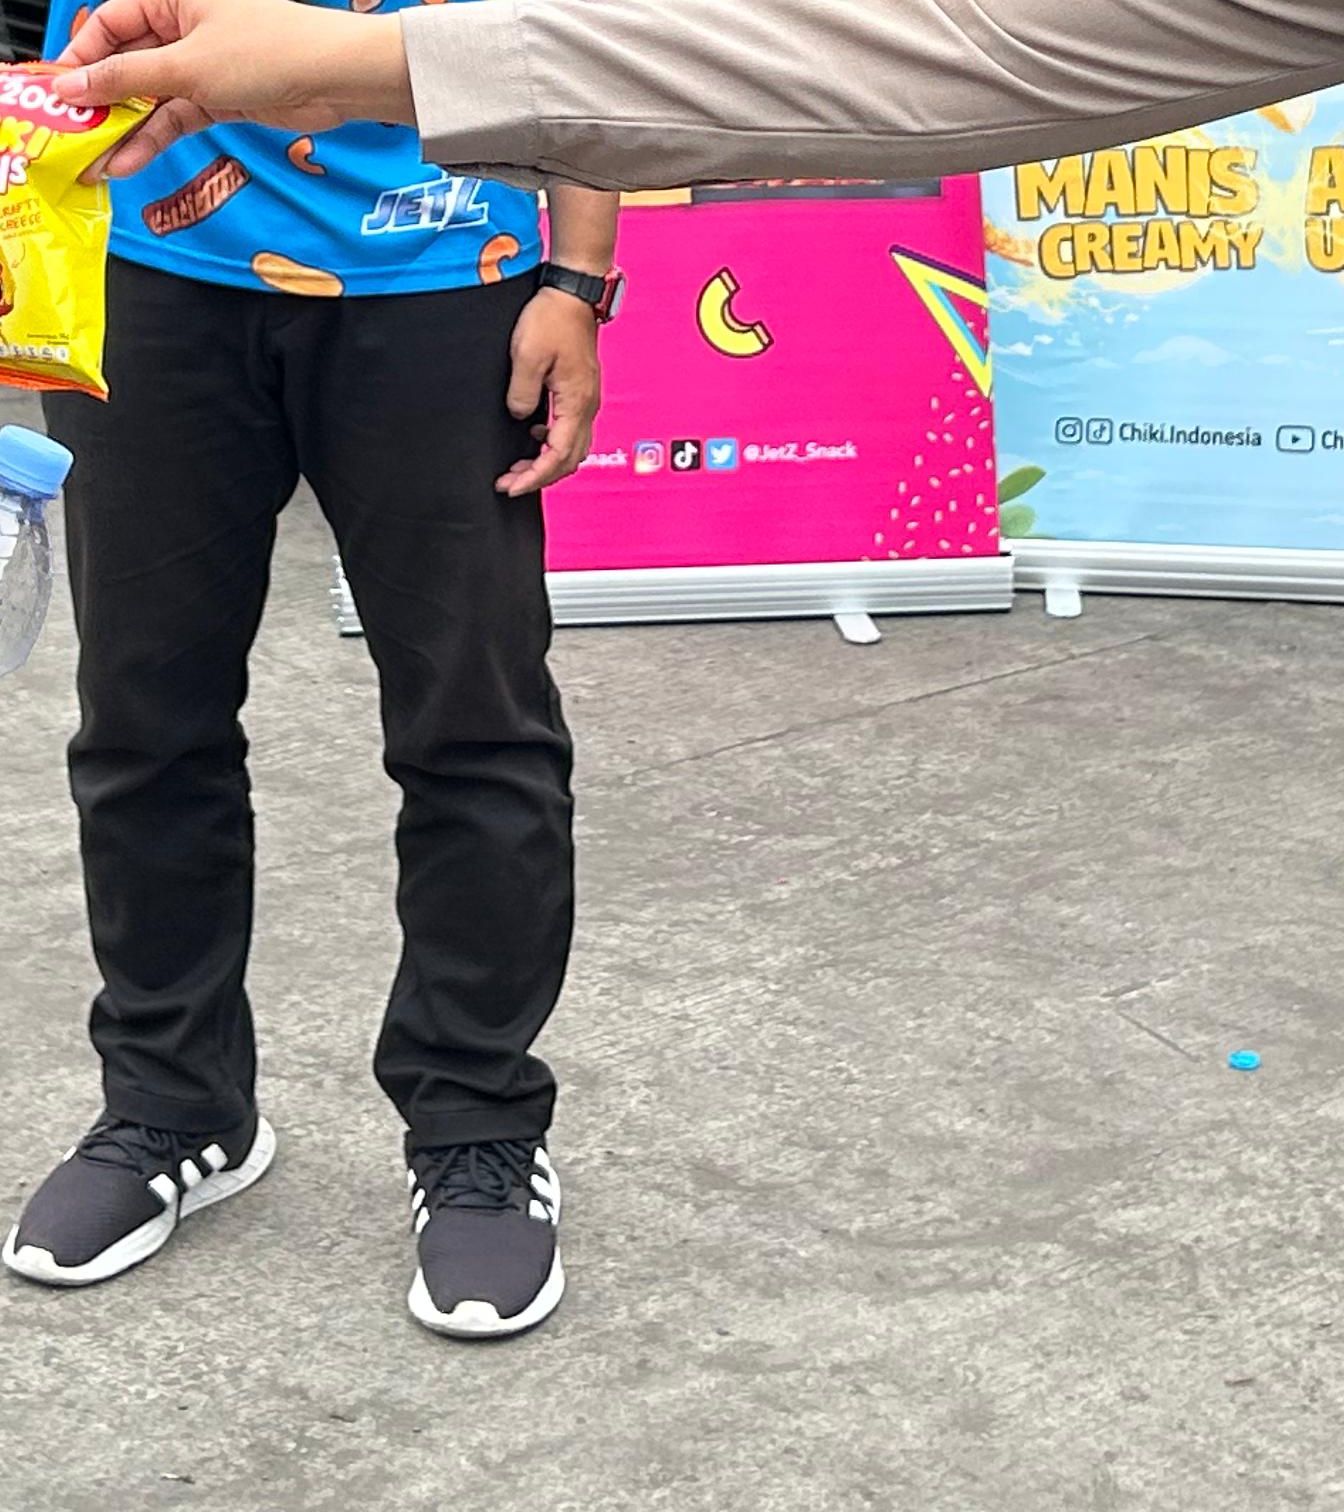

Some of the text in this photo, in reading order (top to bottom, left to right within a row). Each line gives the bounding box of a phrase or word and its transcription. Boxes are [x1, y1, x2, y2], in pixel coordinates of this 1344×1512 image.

[1016, 145, 1258, 220] MANIS
[1039, 218, 1263, 279] CREAMY
[1118, 422, 1262, 448] Chiki.Indonesia
